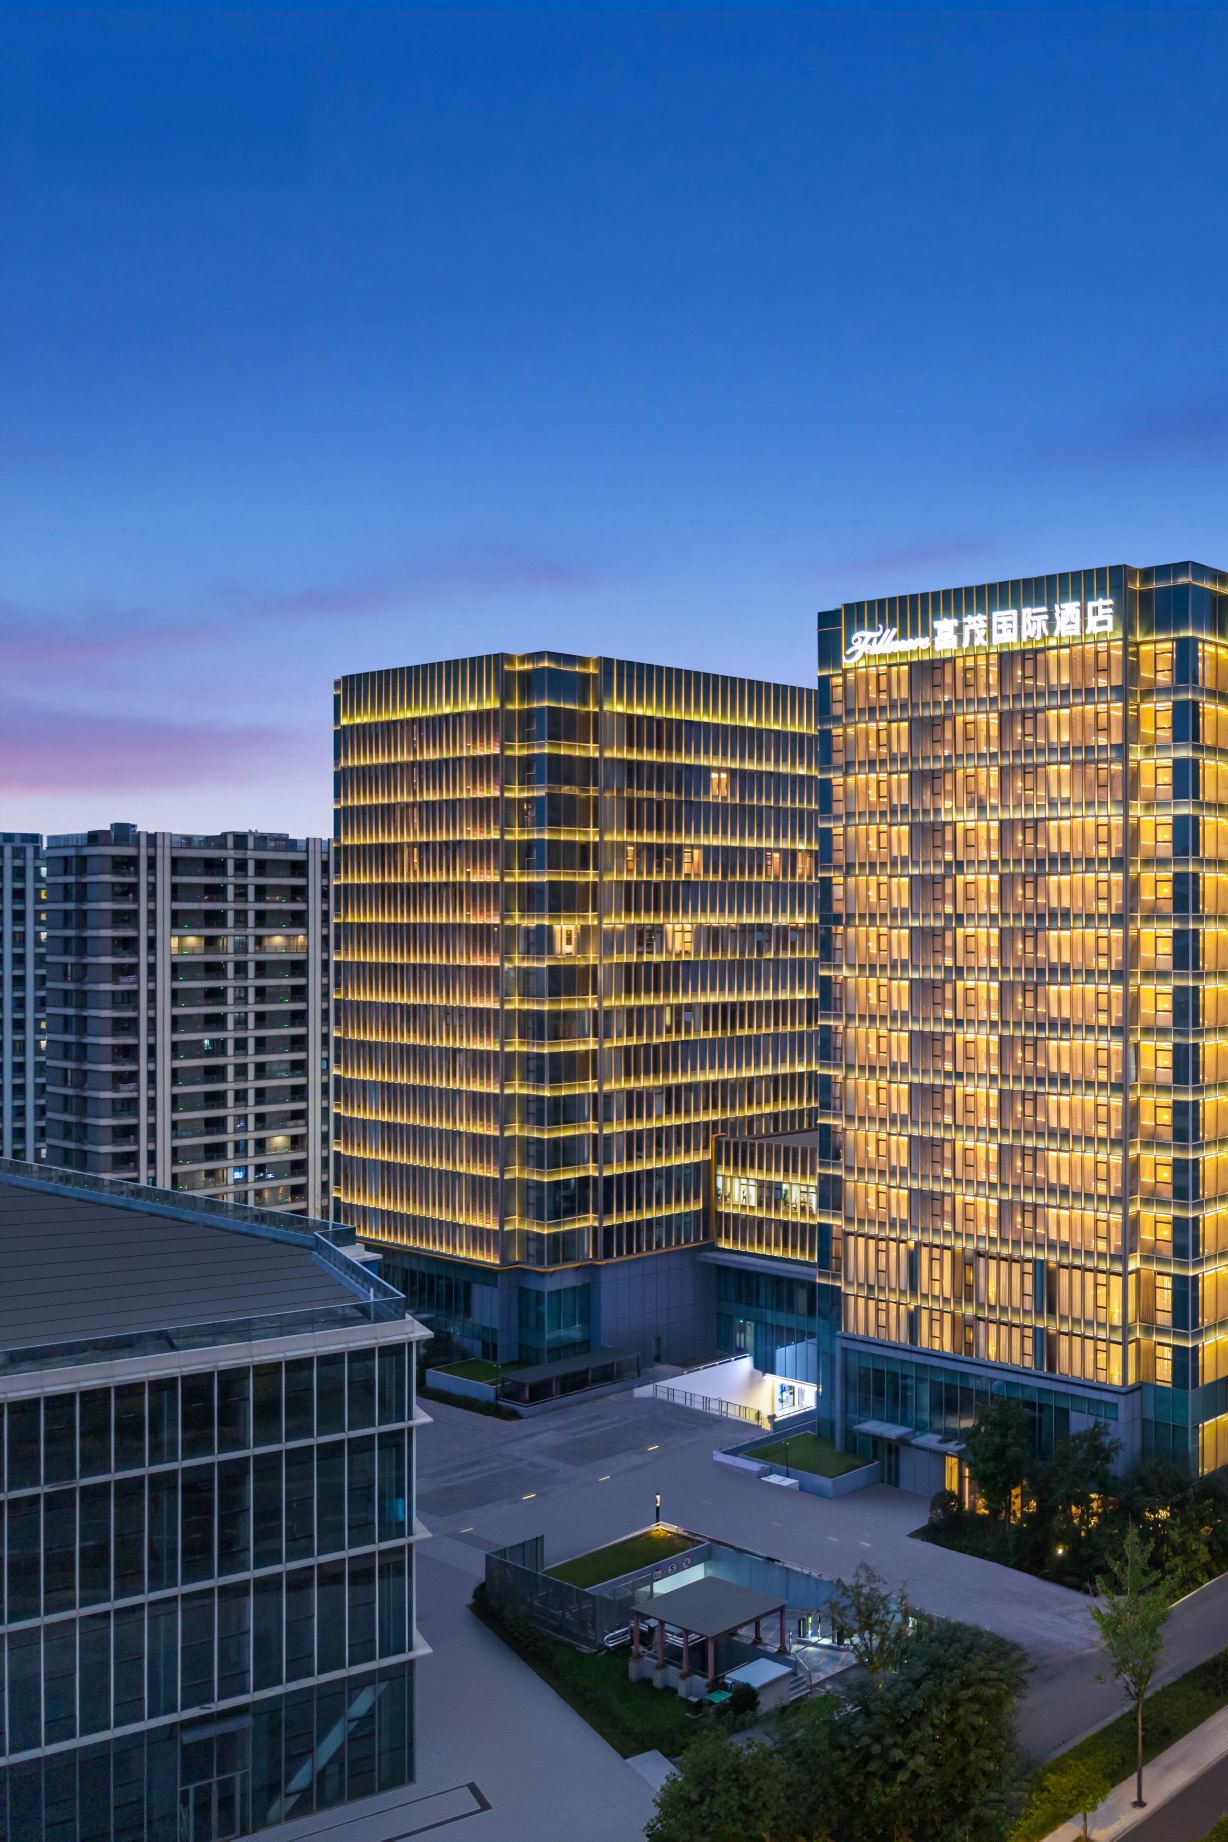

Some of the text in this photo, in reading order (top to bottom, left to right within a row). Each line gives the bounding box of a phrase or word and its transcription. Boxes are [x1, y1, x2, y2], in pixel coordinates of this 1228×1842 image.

[933, 598, 1114, 651] 富茂国际酒店
